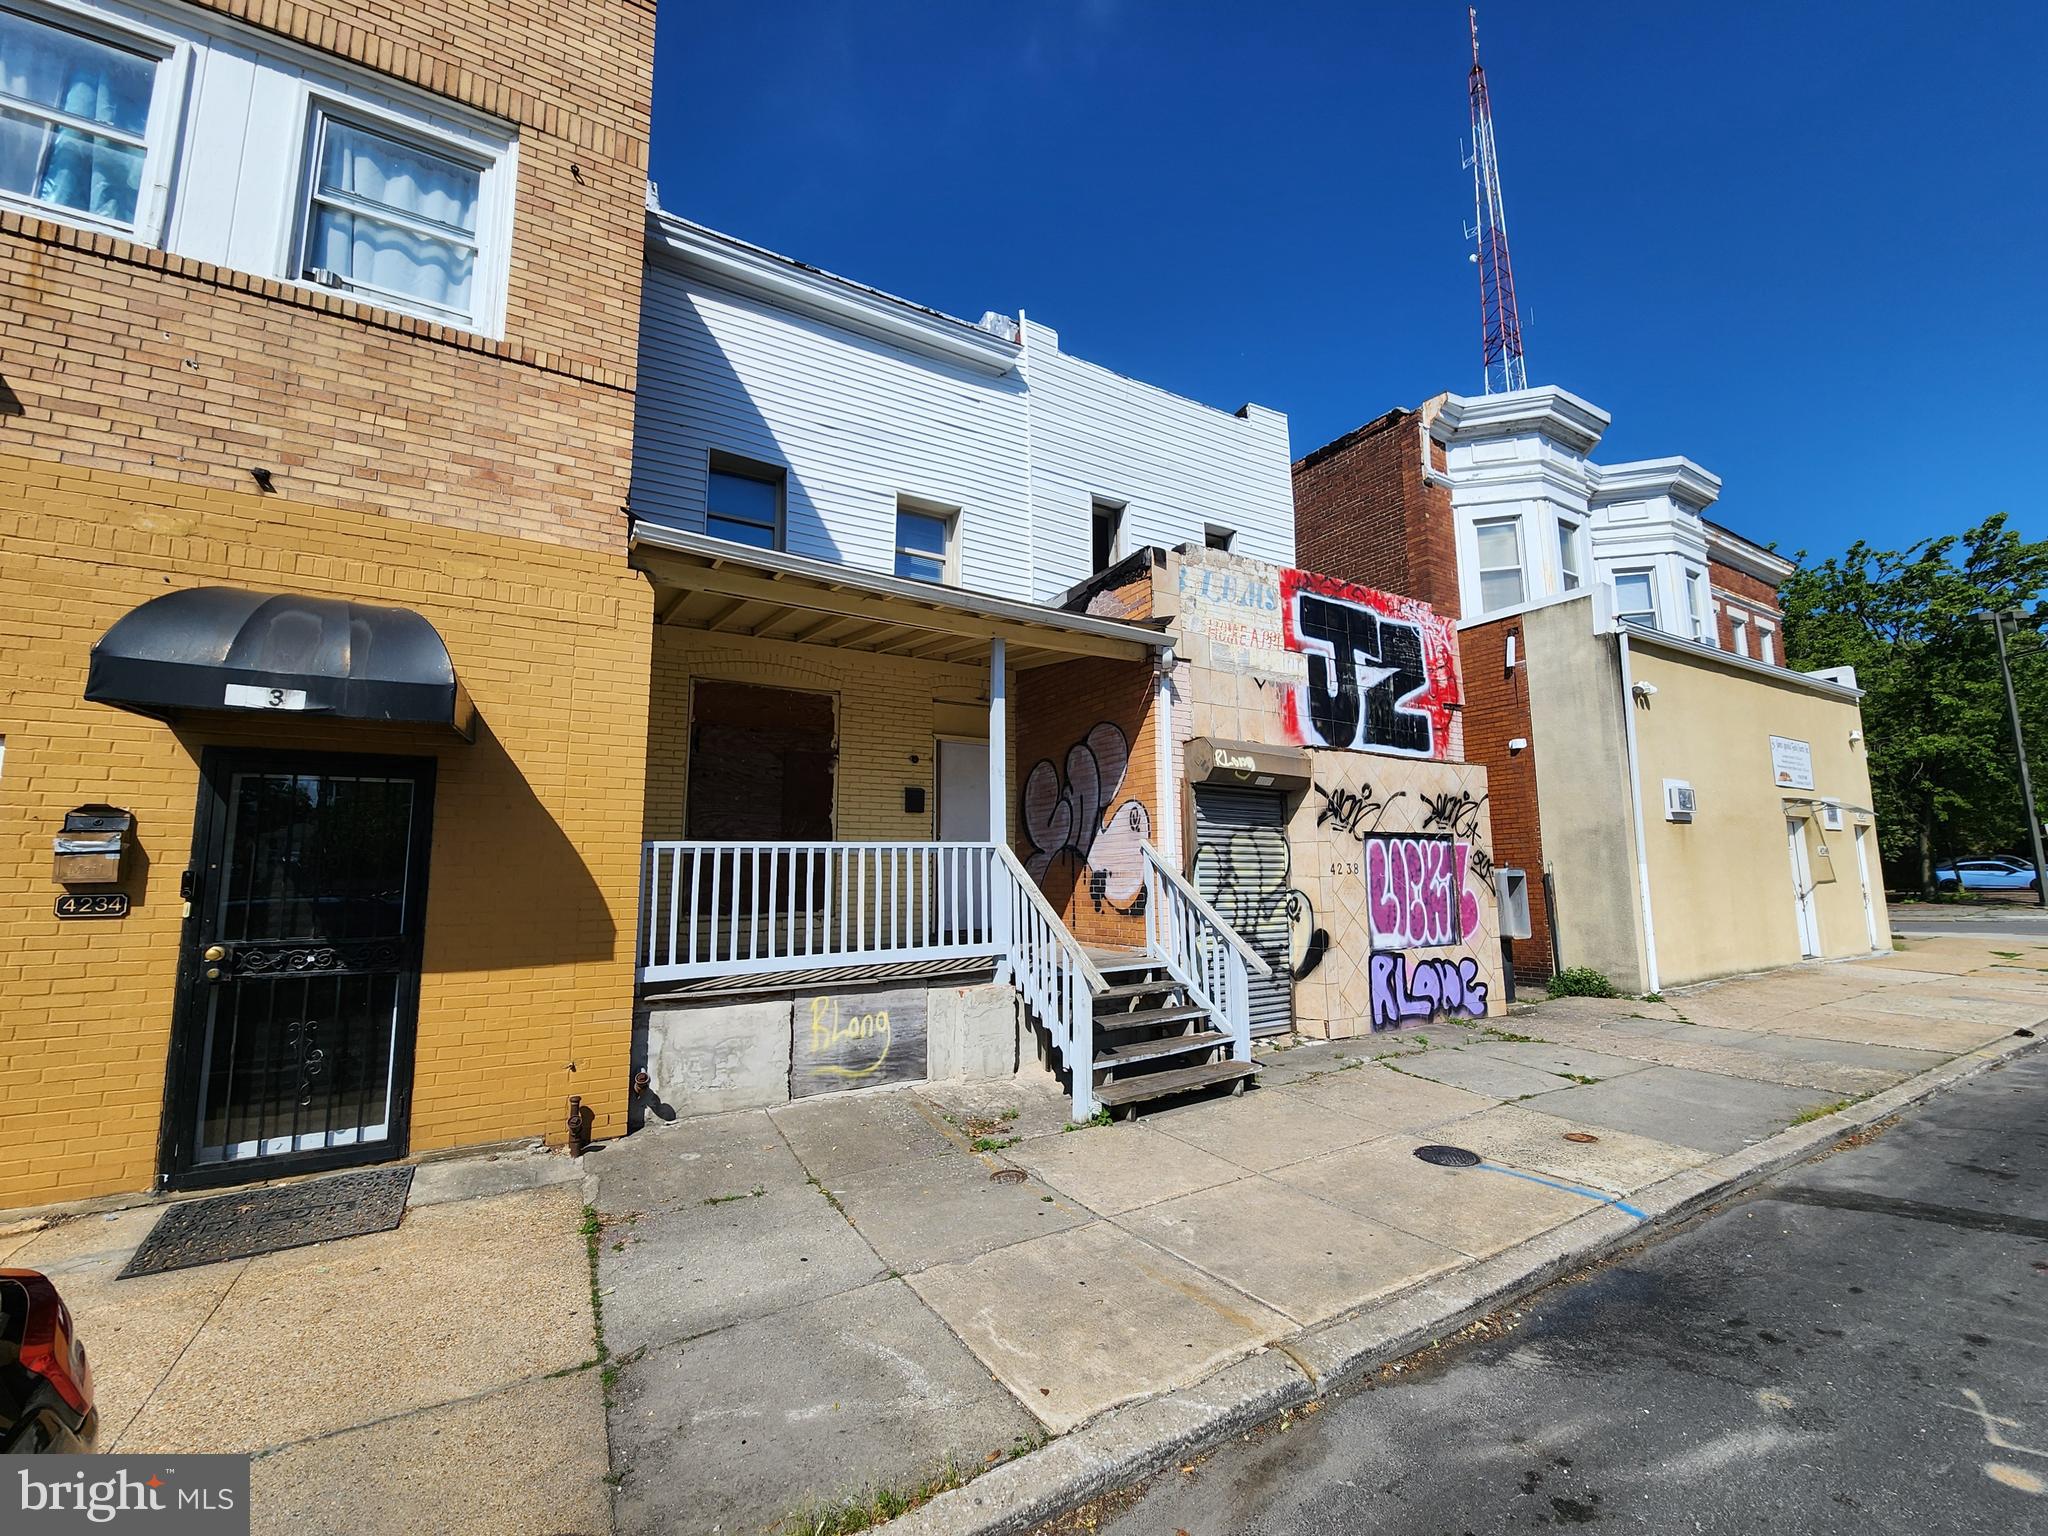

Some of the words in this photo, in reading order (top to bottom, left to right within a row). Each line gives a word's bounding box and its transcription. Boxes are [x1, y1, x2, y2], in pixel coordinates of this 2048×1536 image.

[269, 689, 284, 706] 3
[1330, 862, 1359, 875] 4238
[62, 896, 122, 912] 4234
